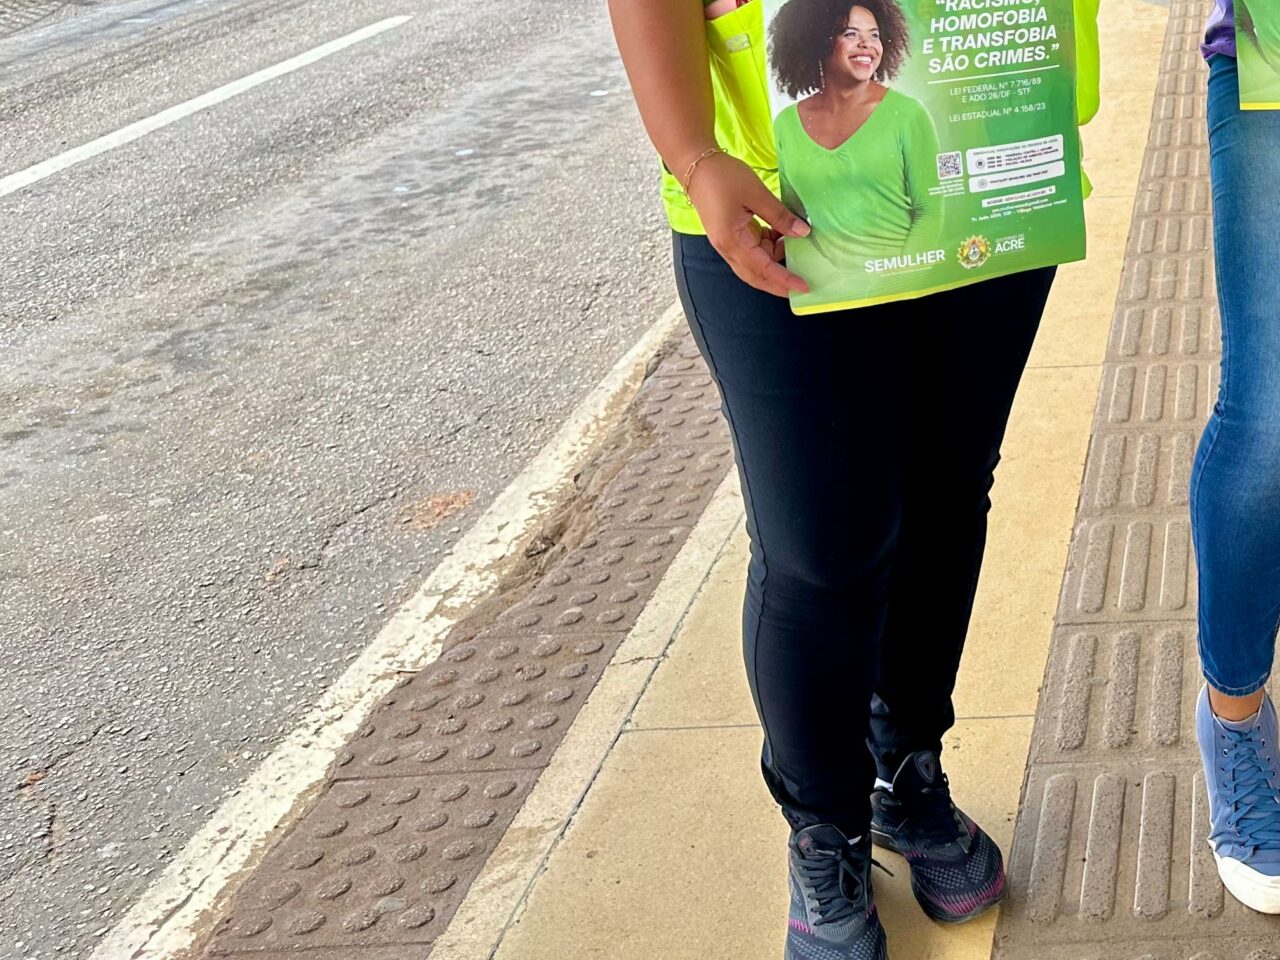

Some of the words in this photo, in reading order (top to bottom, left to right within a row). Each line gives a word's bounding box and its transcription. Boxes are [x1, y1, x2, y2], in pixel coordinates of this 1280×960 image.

[930, 7, 1048, 33] HOMOFOBIA
[922, 38, 934, 54] E
[939, 25, 1057, 52] TRANSFOBIA
[928, 52, 969, 74] SÃO
[974, 43, 1060, 68] CRIMES.”
[950, 87, 962, 96] LEI
[963, 83, 997, 94] FEDERAL
[969, 92, 986, 102] ADO
[949, 114, 961, 122] LEI
[962, 109, 1001, 121] ESTADUAL
[994, 238, 1025, 254] ACRE
[864, 249, 945, 273] SEMULHER
